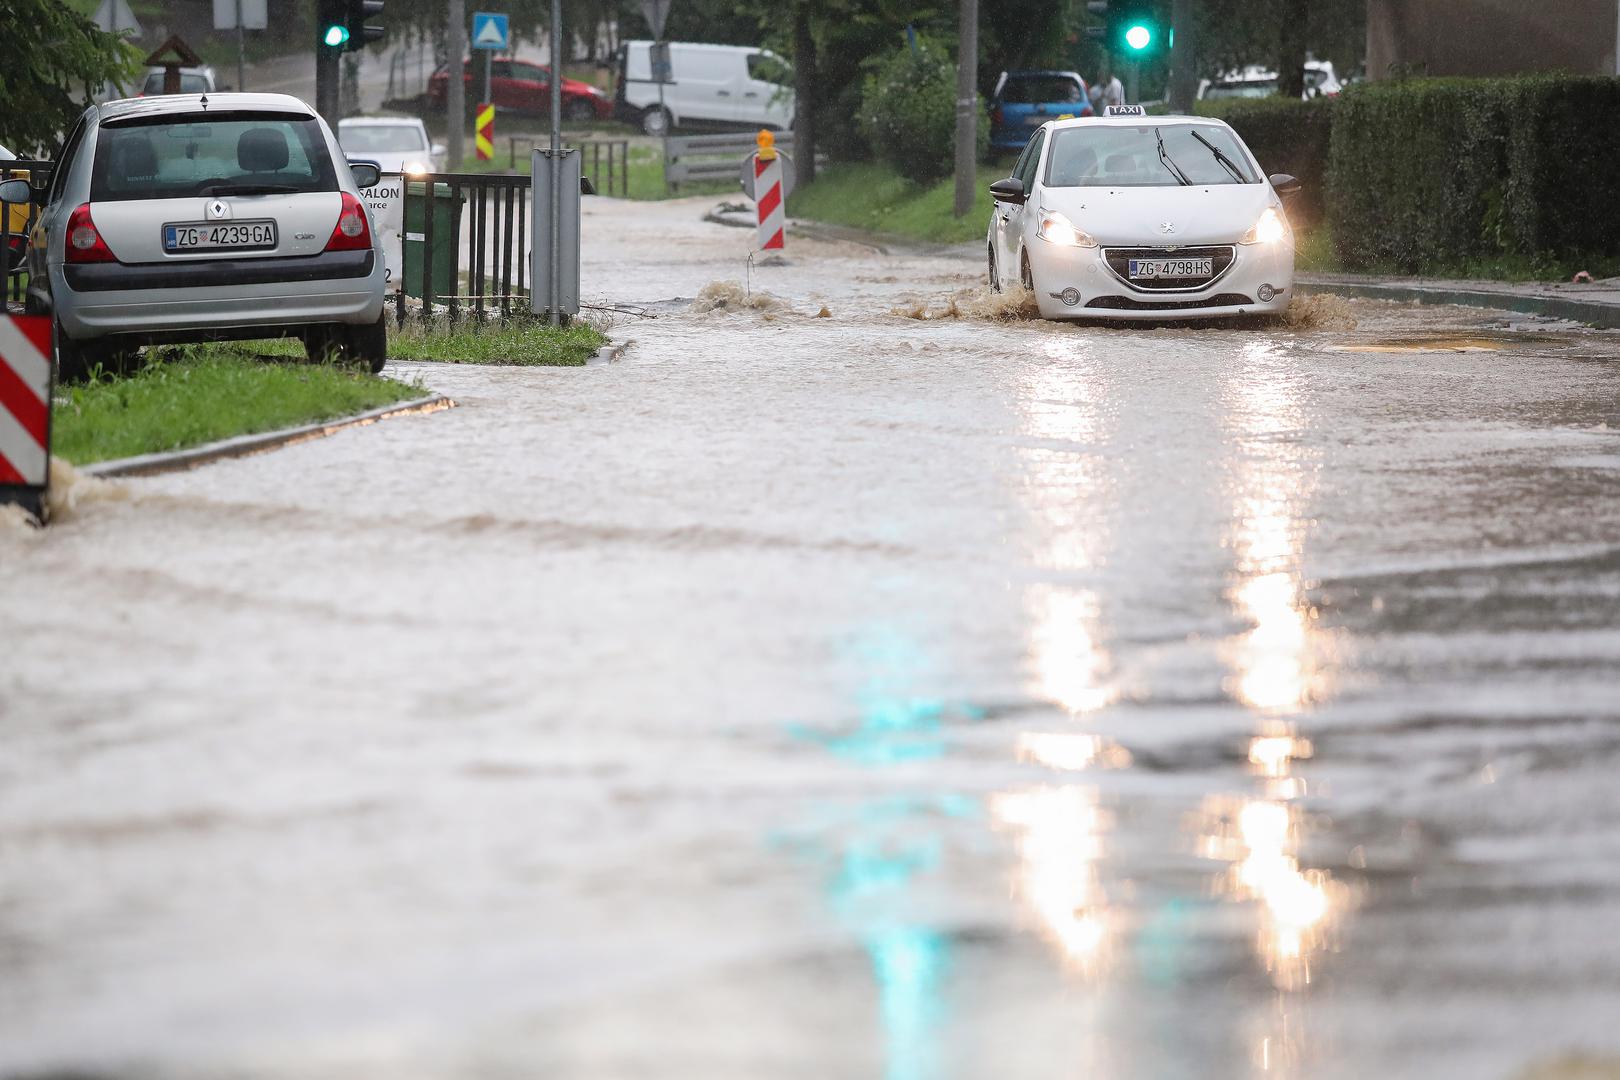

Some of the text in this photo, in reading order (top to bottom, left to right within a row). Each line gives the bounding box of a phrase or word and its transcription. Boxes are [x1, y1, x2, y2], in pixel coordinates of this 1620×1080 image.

[1111, 106, 1139, 114] TAXI
[358, 188, 400, 199] SALON
[177, 228, 198, 246] ZG
[1138, 262, 1154, 276] ZG
